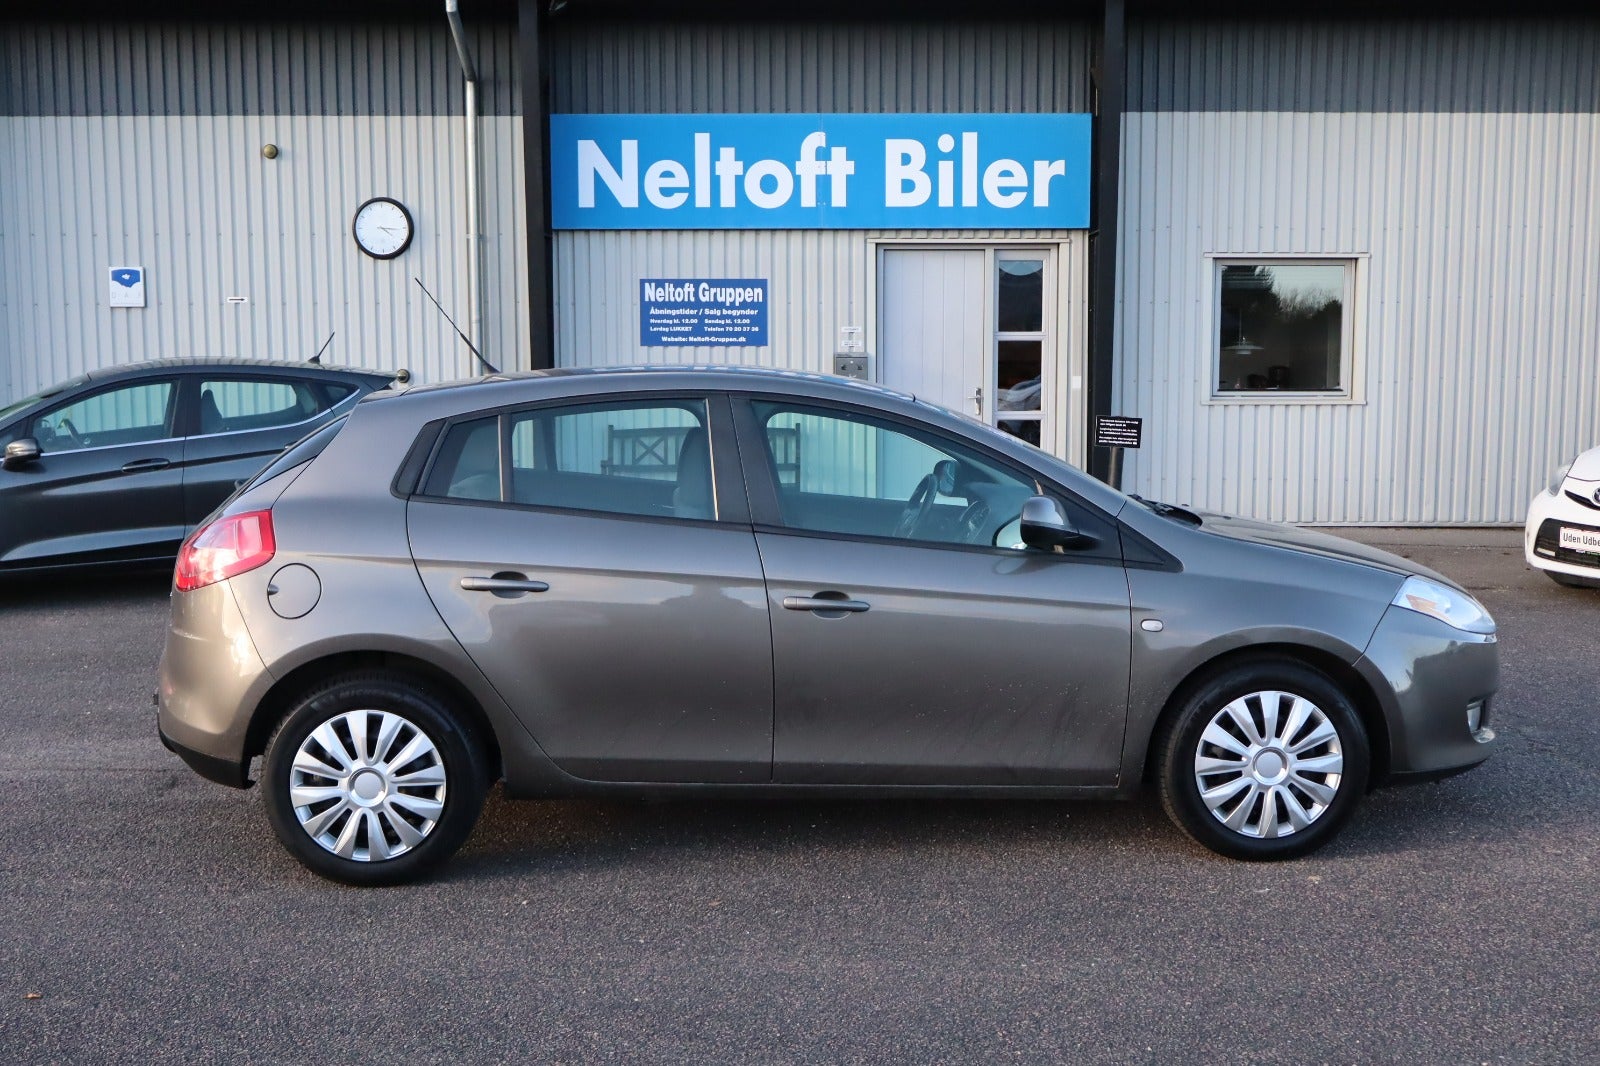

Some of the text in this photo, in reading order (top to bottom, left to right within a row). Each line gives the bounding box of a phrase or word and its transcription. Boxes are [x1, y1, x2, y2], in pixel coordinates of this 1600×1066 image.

[578, 131, 1066, 209] Neltoft Biler
[644, 282, 763, 306] Neltoft Gruppen
[649, 305, 759, 316] Åbningstider / Salg begynder
[1563, 532, 1581, 544] Uden
